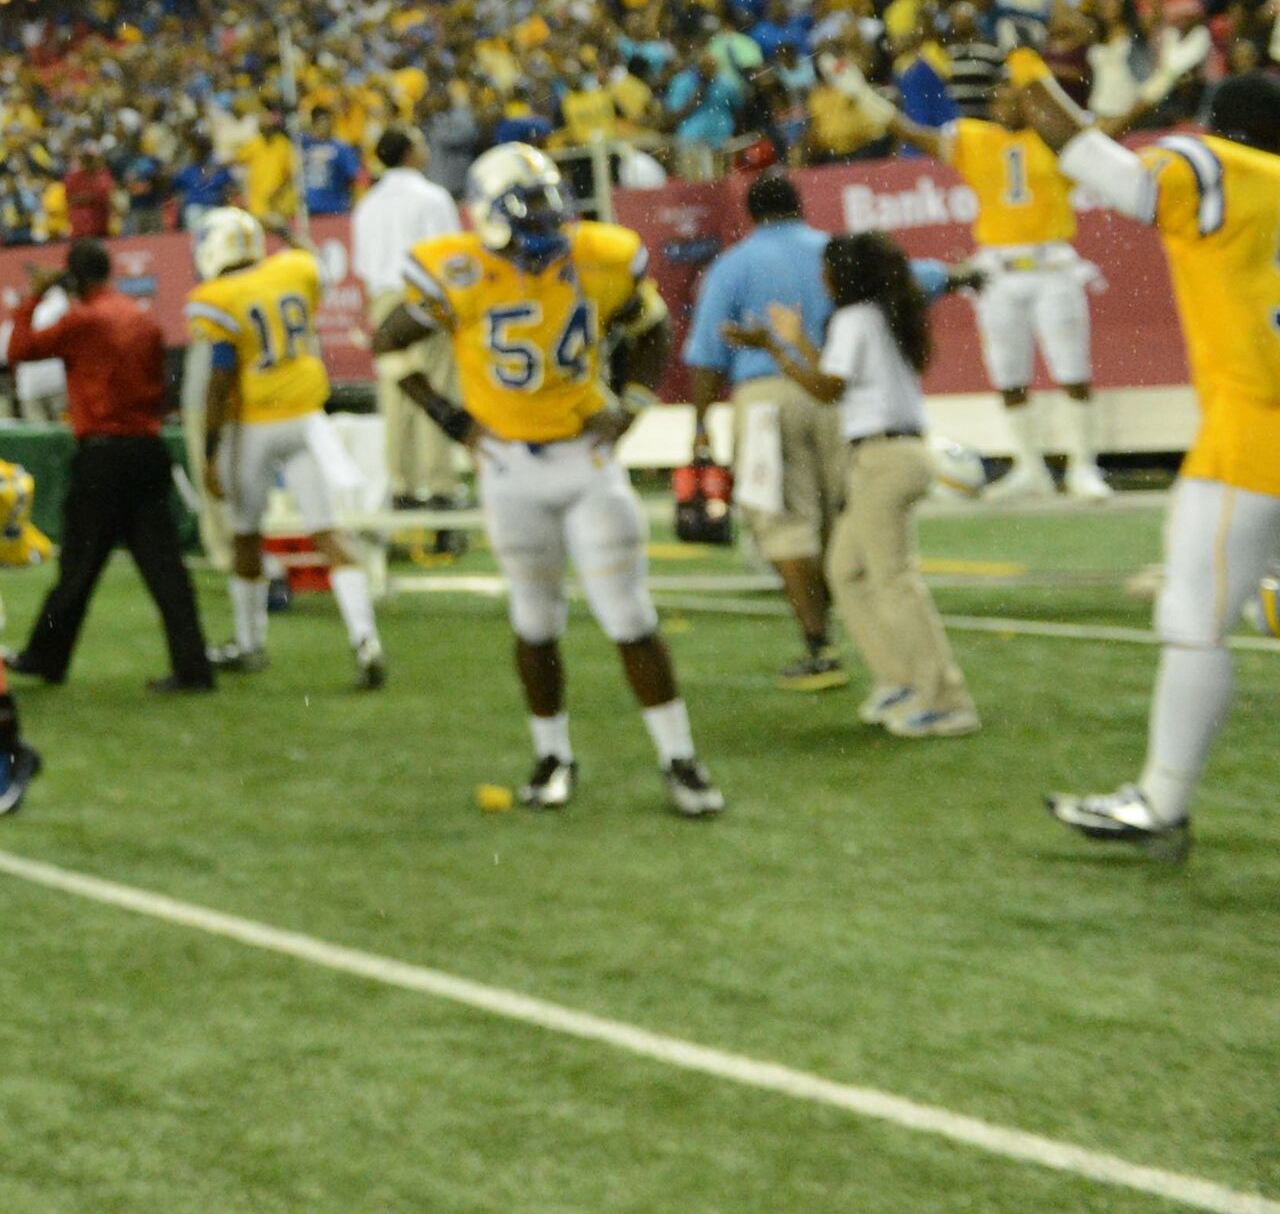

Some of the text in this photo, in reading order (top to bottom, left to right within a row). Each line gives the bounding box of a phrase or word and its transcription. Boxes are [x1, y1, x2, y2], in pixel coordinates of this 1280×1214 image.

[844, 176, 951, 232] Bank
[1002, 145, 1033, 205] 1
[487, 297, 599, 393] 54
